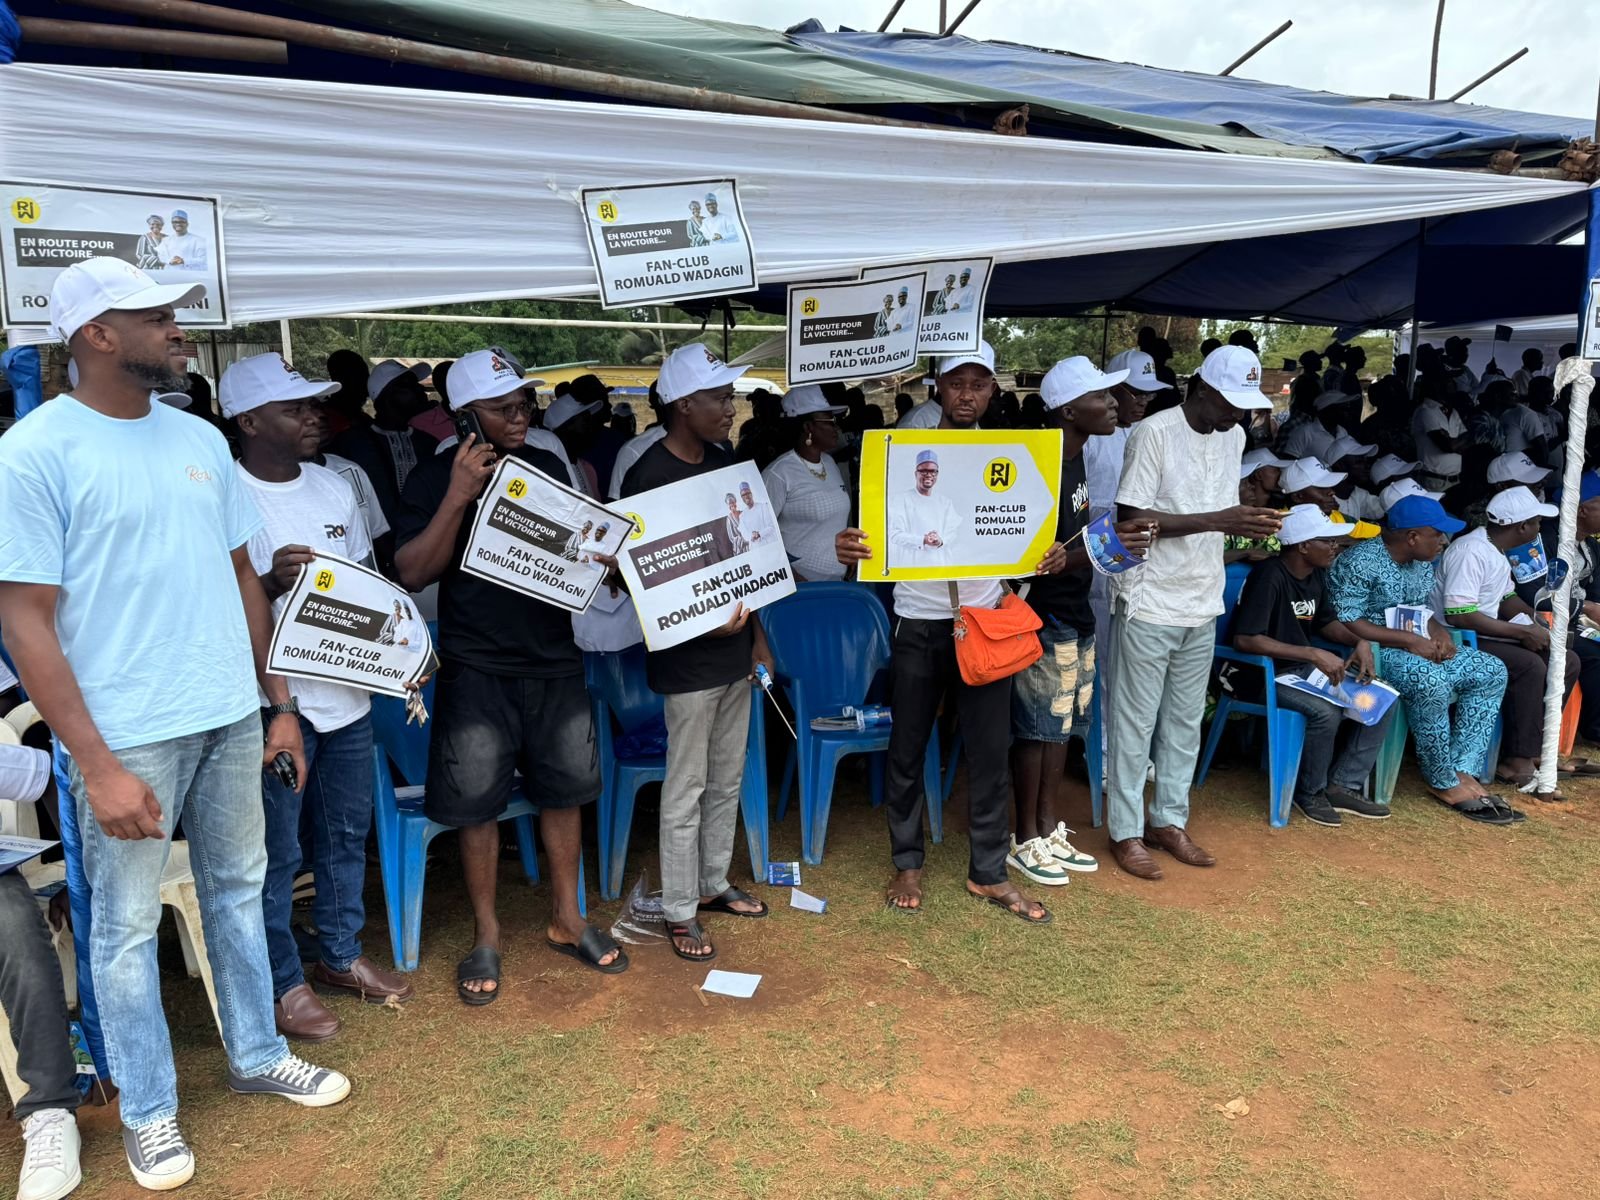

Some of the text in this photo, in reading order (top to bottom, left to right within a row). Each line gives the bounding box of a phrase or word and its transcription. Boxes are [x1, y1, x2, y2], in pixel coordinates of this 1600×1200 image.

[607, 228, 672, 241] EN ROUTE POUR
[20, 238, 114, 250] EN ROUTE POUR
[609, 240, 621, 249] LA
[21, 249, 37, 258] LA
[646, 255, 710, 272] FAN-CLUB
[614, 264, 744, 291] ROMUALD WADAGNI
[815, 322, 841, 331] ROUTE
[841, 321, 862, 329] POUR
[803, 331, 814, 339] LA
[829, 344, 885, 359] FAN-CLUB
[799, 349, 910, 373] ROMUALD WADAGNI
[975, 504, 1026, 513] FAN-CLUB
[493, 512, 504, 523] LA
[497, 505, 557, 538] EN ROUTE POUR
[975, 516, 1026, 525] ROMUALD
[975, 527, 1025, 536] WADAGNI
[637, 532, 714, 566] EN ROUTE POUR
[507, 545, 565, 576] FAN-CLUB
[476, 547, 586, 598] ROMUALD WADAGNI
[641, 563, 658, 576] LA
[692, 564, 753, 597] FAN-CLUB
[657, 567, 788, 631] ROMUALD WADAGNI
[302, 608, 314, 619] LA
[306, 600, 372, 625] EN ROUTE POUR
[318, 638, 381, 662] FAN-CLUB
[282, 645, 405, 680] ROMUALD WADAGNI
